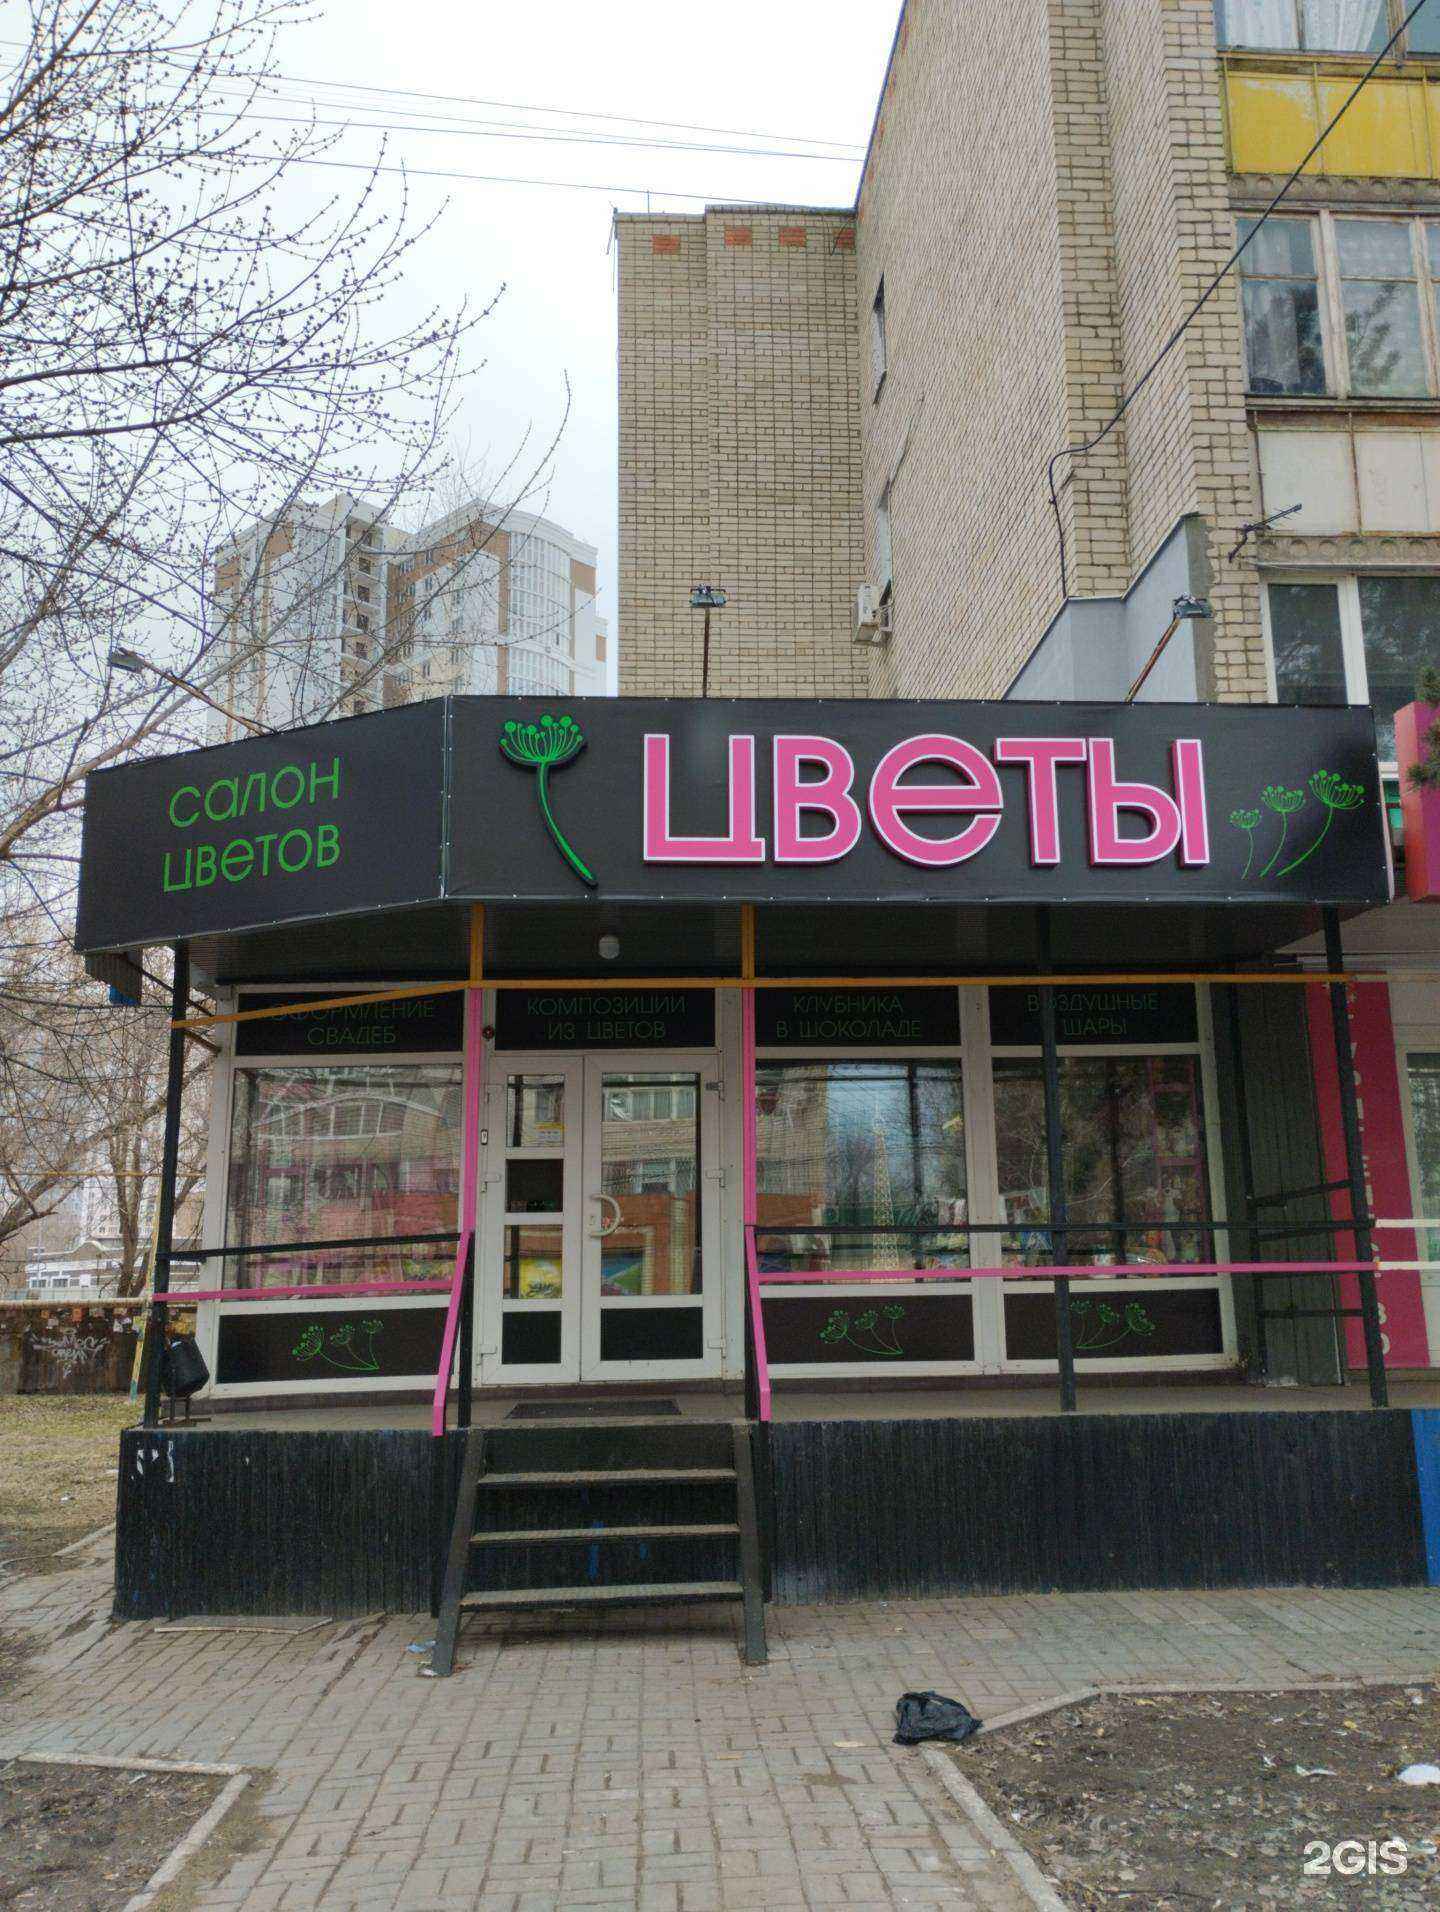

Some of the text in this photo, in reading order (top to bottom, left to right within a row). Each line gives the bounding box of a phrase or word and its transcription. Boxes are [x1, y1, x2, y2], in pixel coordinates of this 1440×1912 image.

[528, 996, 686, 1016] КОМПОЗИЦИИ
[793, 994, 904, 1014] КЛУБНИКА
[1027, 992, 1160, 1012] ВЗДУШНЫЕ
[307, 1026, 396, 1046] СВАДЕБ
[547, 1020, 666, 1041] ИЗ ЦВЕТОВ
[776, 1020, 922, 1039] В ШОКОЛАДЕ
[1064, 1017, 1127, 1036] ШАРЫ
